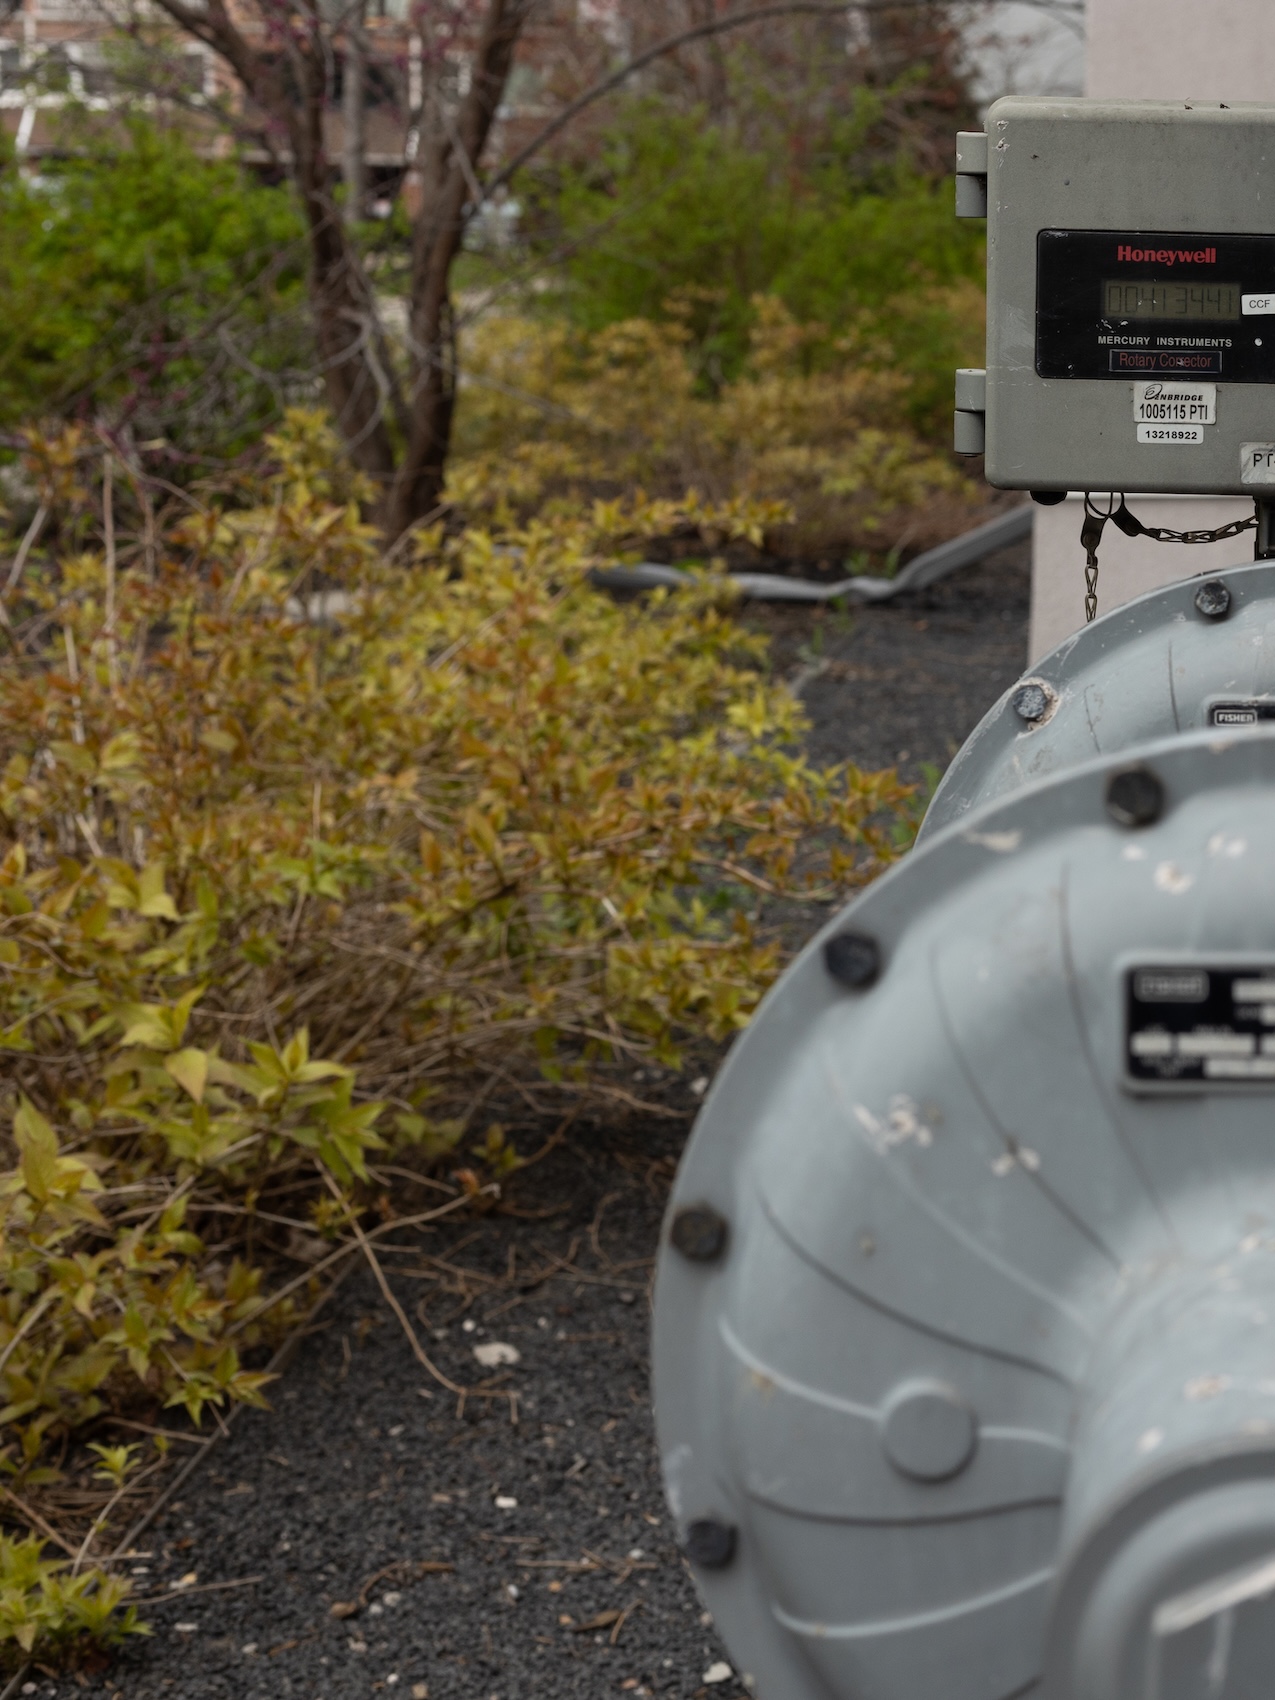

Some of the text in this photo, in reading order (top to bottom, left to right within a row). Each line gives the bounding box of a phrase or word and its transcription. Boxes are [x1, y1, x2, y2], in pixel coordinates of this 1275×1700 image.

[1117, 245, 1217, 267] Honeywell
[1249, 299, 1271, 309] CCF
[1097, 336, 1233, 348] MERCURY INSTRUMENTS
[1119, 353, 1212, 370] Rotary Corrector
[1146, 388, 1204, 402] ENBRIDGE
[1139, 403, 1208, 420] 1005115 PTI
[1145, 430, 1198, 440] 13218922
[1218, 713, 1254, 723] FISHER
